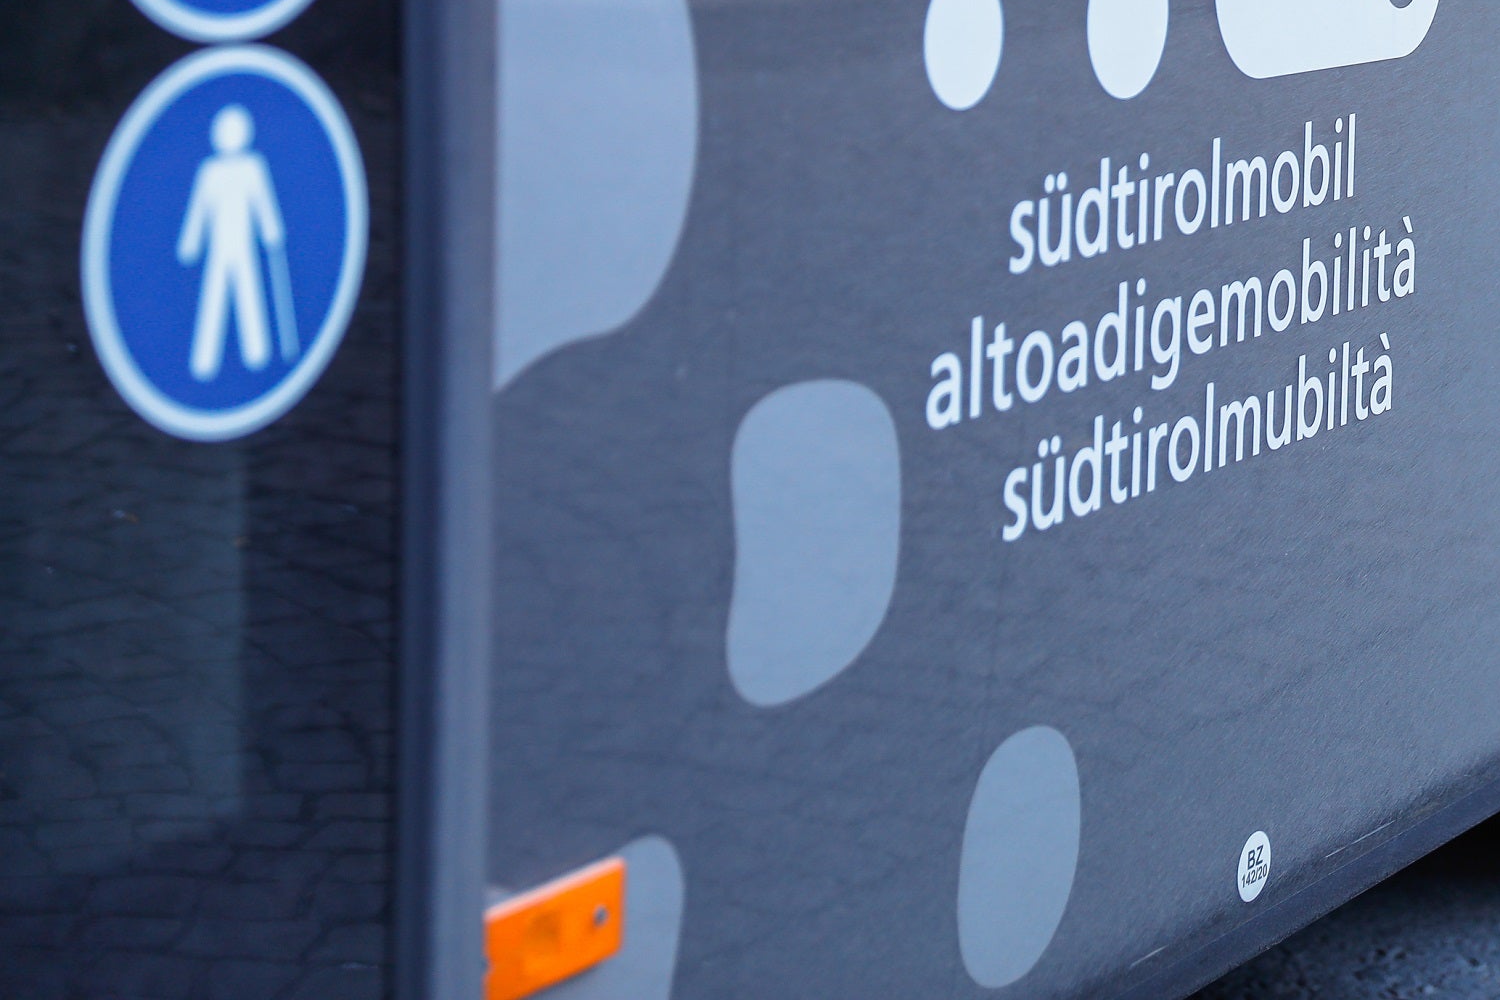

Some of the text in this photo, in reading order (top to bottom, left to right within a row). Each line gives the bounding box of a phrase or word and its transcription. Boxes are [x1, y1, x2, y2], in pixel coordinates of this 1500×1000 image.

[1008, 112, 1357, 275] südtirolmobil
[925, 214, 1417, 431] altoadigemobilità
[1001, 331, 1394, 543] südtirolmubiltà
[1241, 863, 1268, 888] 142/20
[1247, 845, 1264, 870] BZ
